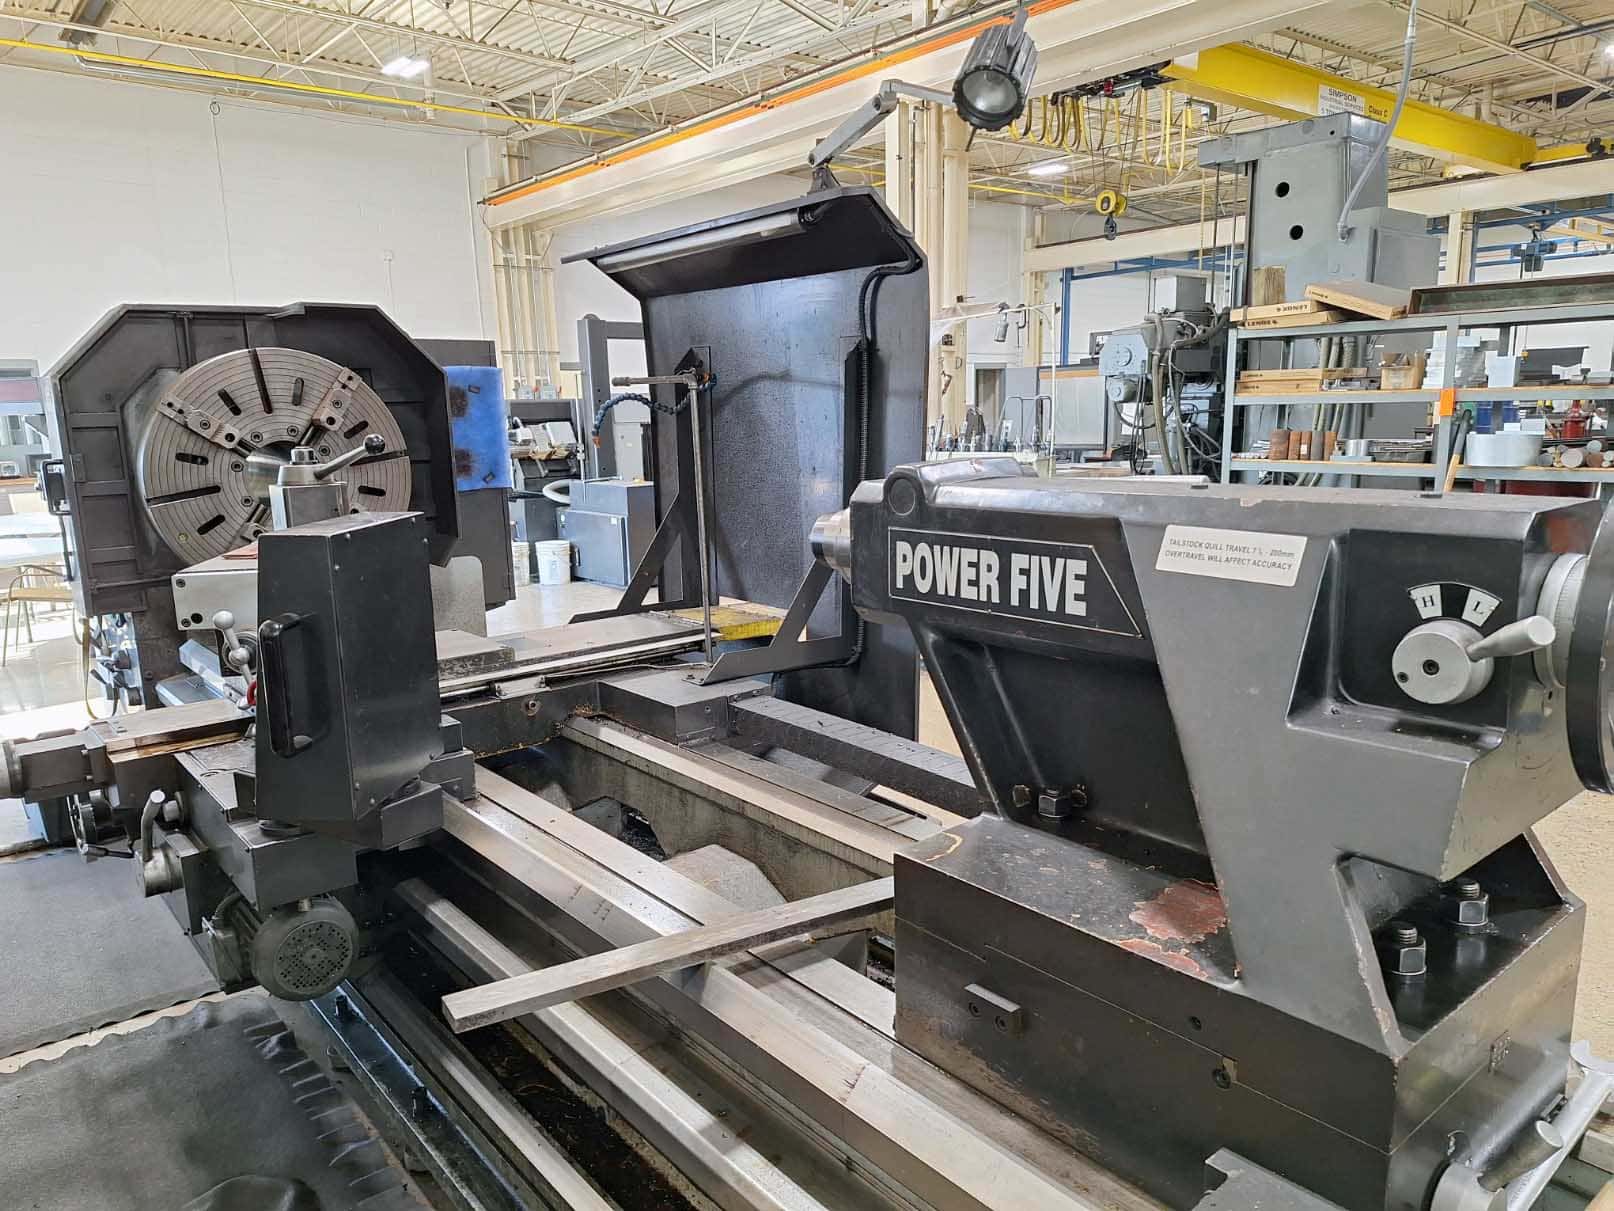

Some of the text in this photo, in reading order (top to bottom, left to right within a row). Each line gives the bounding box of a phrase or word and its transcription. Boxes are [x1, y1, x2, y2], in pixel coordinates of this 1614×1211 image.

[1328, 87, 1357, 103] SIMPSON
[1169, 538, 1204, 548] TAILSTOCK
[1204, 542, 1223, 551] QUILL
[1225, 544, 1250, 554] TRAVEL
[1165, 550, 1293, 571] OVERTRAVEL WILL AFFECT ACCURACY
[895, 540, 1088, 617] POWER FIVE
[1422, 595, 1435, 608] H
[1472, 600, 1484, 615] L
